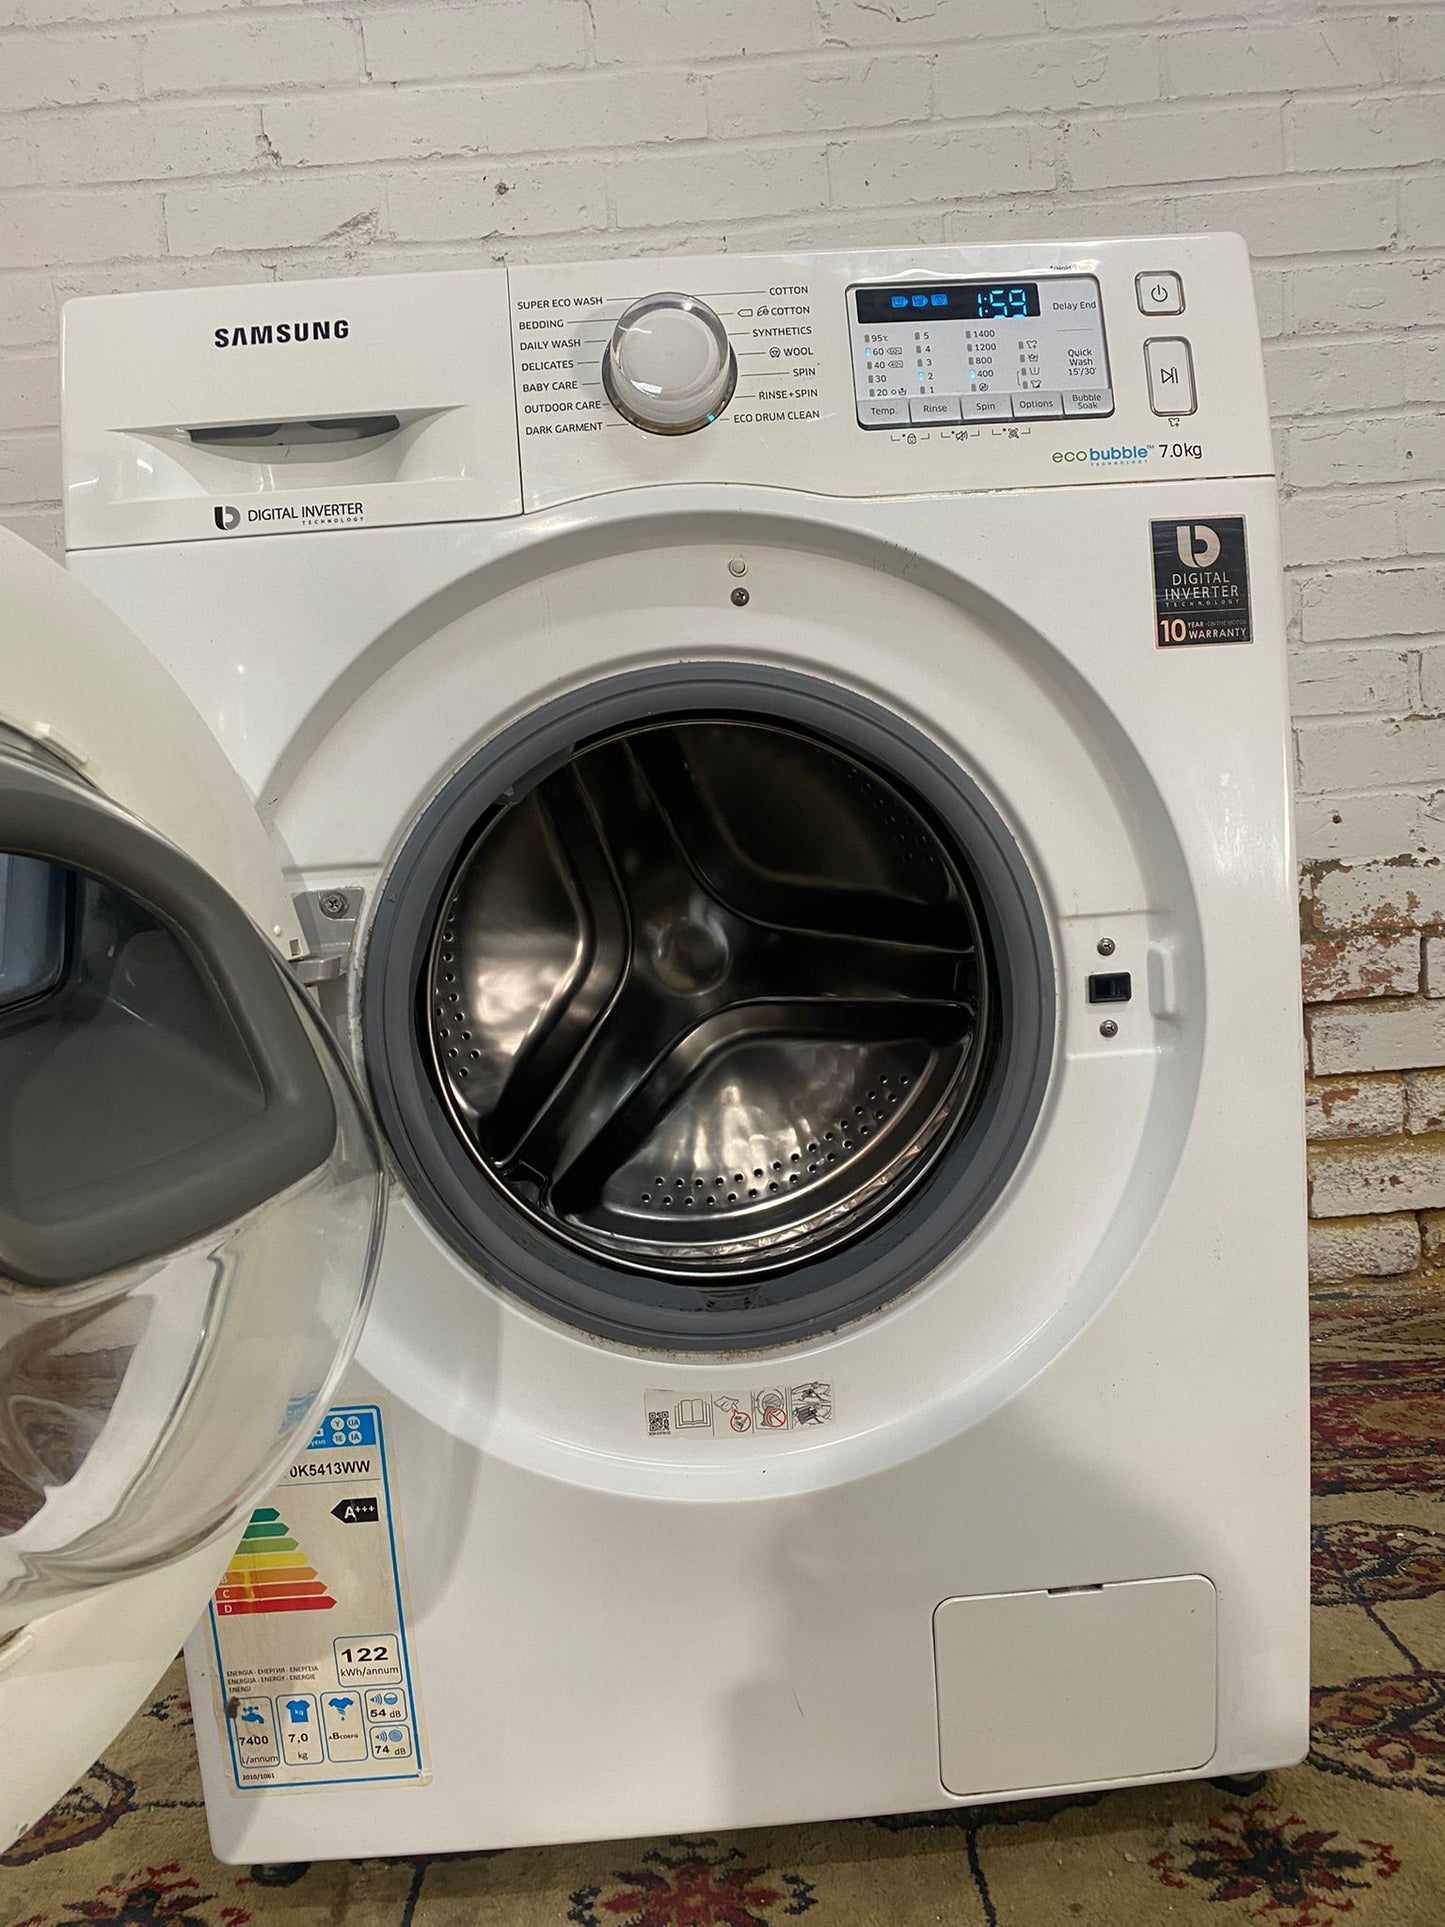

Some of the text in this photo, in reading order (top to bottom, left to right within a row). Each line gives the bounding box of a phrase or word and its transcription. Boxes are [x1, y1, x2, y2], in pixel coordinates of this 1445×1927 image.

[769, 286, 809, 296] COTTON
[517, 296, 603, 311] SUPER ECO WASH
[977, 289, 1027, 319] 1:59
[1052, 300, 1096, 312] Delay End
[771, 306, 810, 316] COTTON
[519, 319, 564, 330] BEDDING
[215, 319, 349, 348] SAMSUNG
[752, 326, 812, 337] SYNTHETICS
[923, 331, 930, 340] 5
[973, 329, 995, 338] 1400
[519, 338, 581, 351] DAILY WASH
[924, 345, 931, 353] 4
[975, 342, 997, 352] 1200
[783, 347, 814, 357] WOOL
[872, 347, 884, 356] 60
[1067, 348, 1092, 358] Quick
[874, 360, 886, 369] 40
[926, 358, 932, 367] 3
[976, 356, 993, 365] 800
[1069, 357, 1093, 366] Wash
[521, 360, 574, 372] DELICATES
[792, 367, 816, 378] SPIN
[927, 372, 934, 380] 2
[977, 369, 994, 378] 400
[875, 374, 887, 383] 30
[522, 380, 578, 393] BABY CARE
[929, 386, 935, 394] 1
[758, 389, 818, 400] RINSE+SPIN
[876, 388, 888, 397] 20
[1072, 393, 1102, 402] Bubble
[524, 400, 602, 414] OUTDOOR CARE
[923, 403, 947, 413] Rinse
[976, 401, 996, 413] Spin
[1019, 399, 1054, 410] Options
[1078, 401, 1098, 410] Soak
[733, 410, 820, 424] ECO DRUM CLEAN
[525, 422, 603, 436] DARK GARMENT
[248, 502, 364, 522] DIGITAL INVERTER
[302, 516, 365, 526] TECHNOLOGY
[1172, 571, 1230, 586] DIGITAL
[1165, 584, 1239, 600] INVERTER
[1165, 599, 1240, 608] TECHNOLOGY
[1160, 618, 1187, 643] 10
[1188, 627, 1247, 640] WARRANTY
[348, 1418, 359, 1427] UA
[336, 1434, 344, 1443] IE
[350, 1433, 361, 1442] IA
[288, 1459, 371, 1478] 0K5413WW
[344, 1503, 375, 1519] A+++
[222, 1589, 231, 1599] C
[224, 1604, 232, 1614] D
[341, 1646, 389, 1663] 122
[227, 1668, 254, 1677] ENERGIA
[340, 1665, 399, 1677] kWh/annum
[261, 1675, 285, 1683] ENERGY
[370, 1708, 402, 1719] 54 dB
[239, 1735, 269, 1746] 7400
[287, 1733, 309, 1745] 7,0
[297, 1750, 309, 1761] kg
[374, 1745, 406, 1756] 74 dB
[241, 1753, 279, 1765] L/annum
[242, 1772, 275, 1782] 2010/1061
